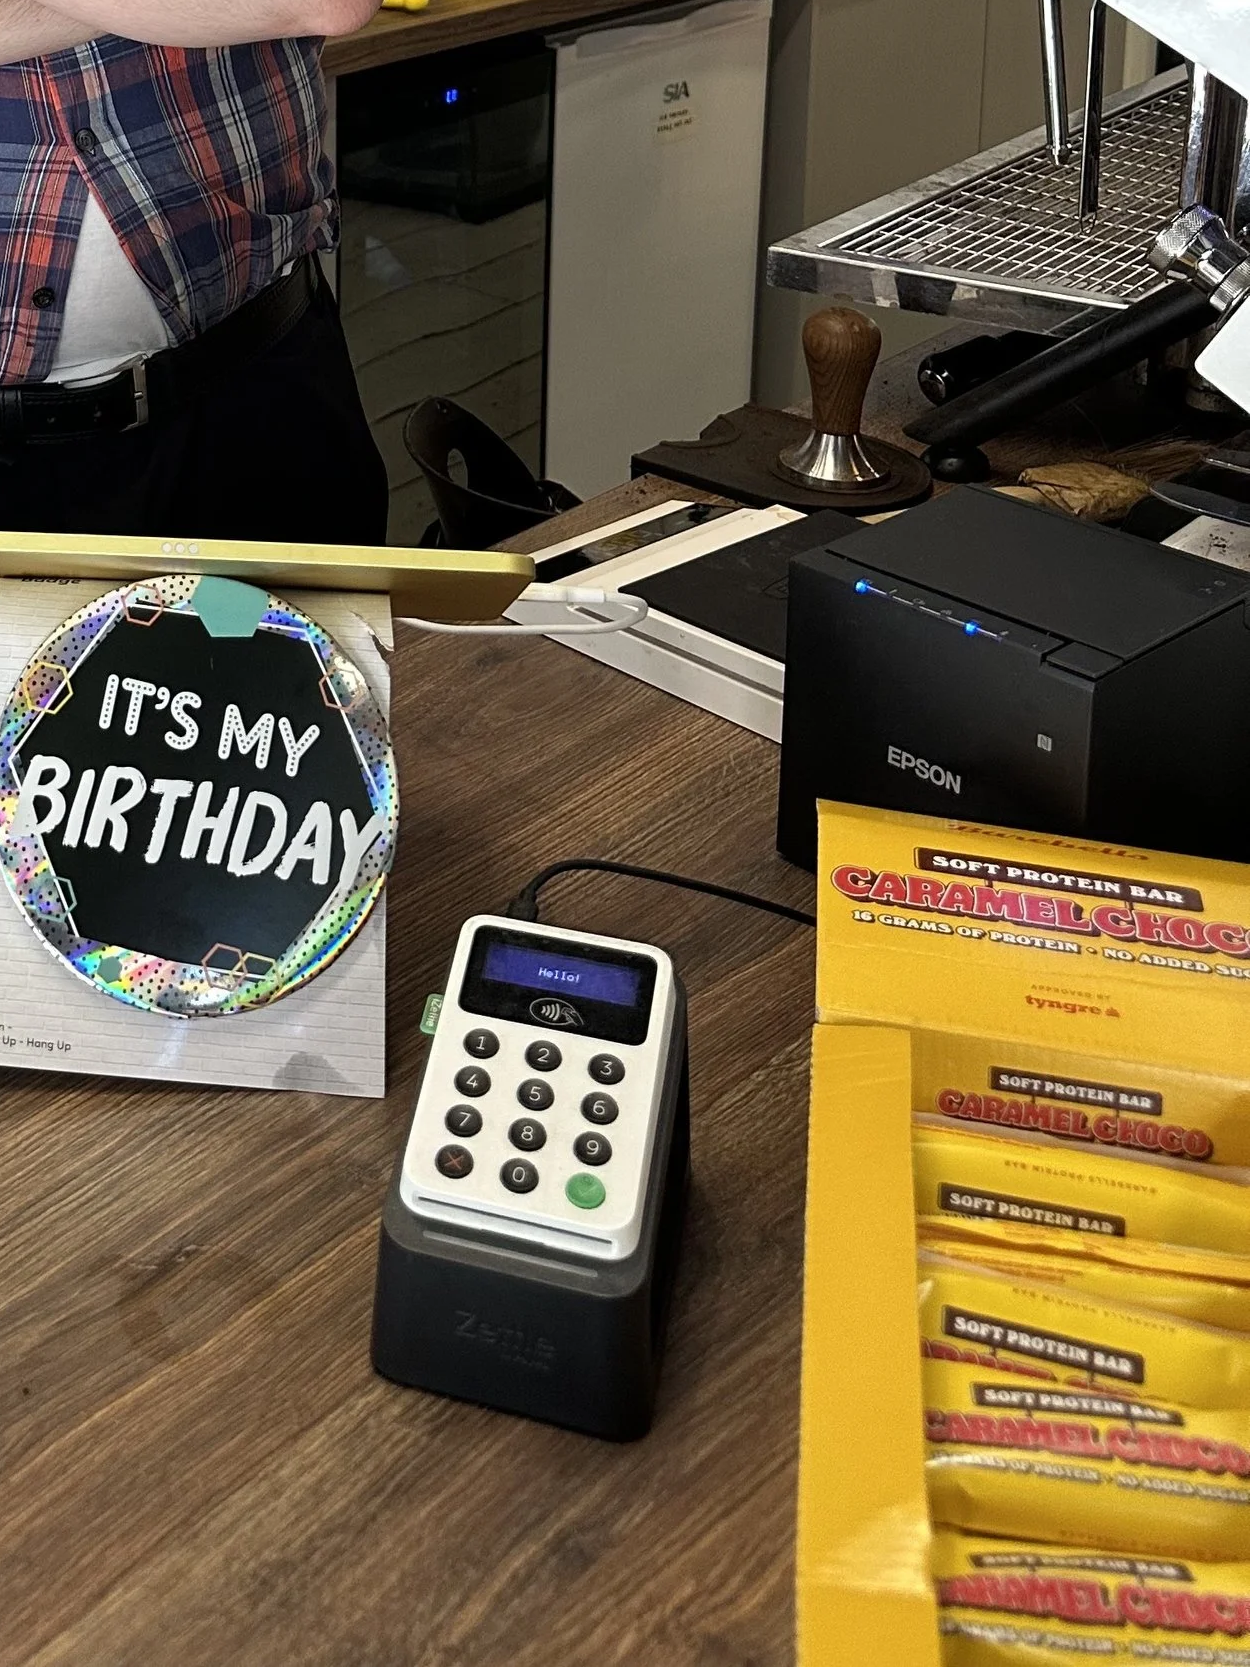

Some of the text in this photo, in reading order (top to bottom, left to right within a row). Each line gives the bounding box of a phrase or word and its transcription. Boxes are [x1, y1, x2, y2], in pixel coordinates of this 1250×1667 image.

[218, 704, 321, 777] MY
[888, 745, 961, 795] EPSON
[15, 755, 387, 893] BIRTHDAY
[932, 855, 1184, 903] SOFT PROTEIN BAR
[831, 864, 1250, 957] CARAMEL CHOC
[852, 909, 874, 922] 16
[878, 914, 952, 934] GRAMS
[957, 925, 985, 939] OF
[990, 931, 1080, 953] PROTEIN
[1103, 947, 1134, 961] NO
[1139, 953, 1212, 973] ADDED
[1025, 995, 1102, 1015] tyngre
[2, 1036, 16, 1047] Up
[27, 1038, 54, 1051] Hang
[57, 1040, 71, 1052] Up
[476, 1036, 612, 1076] 1 2 3
[466, 1073, 605, 1115] 4 5 6
[1000, 1074, 1152, 1109] SOFT PROTEIN BAR
[459, 1111, 599, 1155] 7 8 9
[936, 1088, 1212, 1159] CARAMEL CHOCO
[512, 1166, 526, 1183] 0
[949, 1192, 1114, 1235] SOFT PROTEIN BAR
[954, 1316, 1003, 1340] SOFT
[1007, 1330, 1089, 1362] PROTEIN
[1093, 1351, 1133, 1374] BAR
[983, 1388, 1035, 1405] SOFT
[1039, 1394, 1124, 1415] PROTEIN
